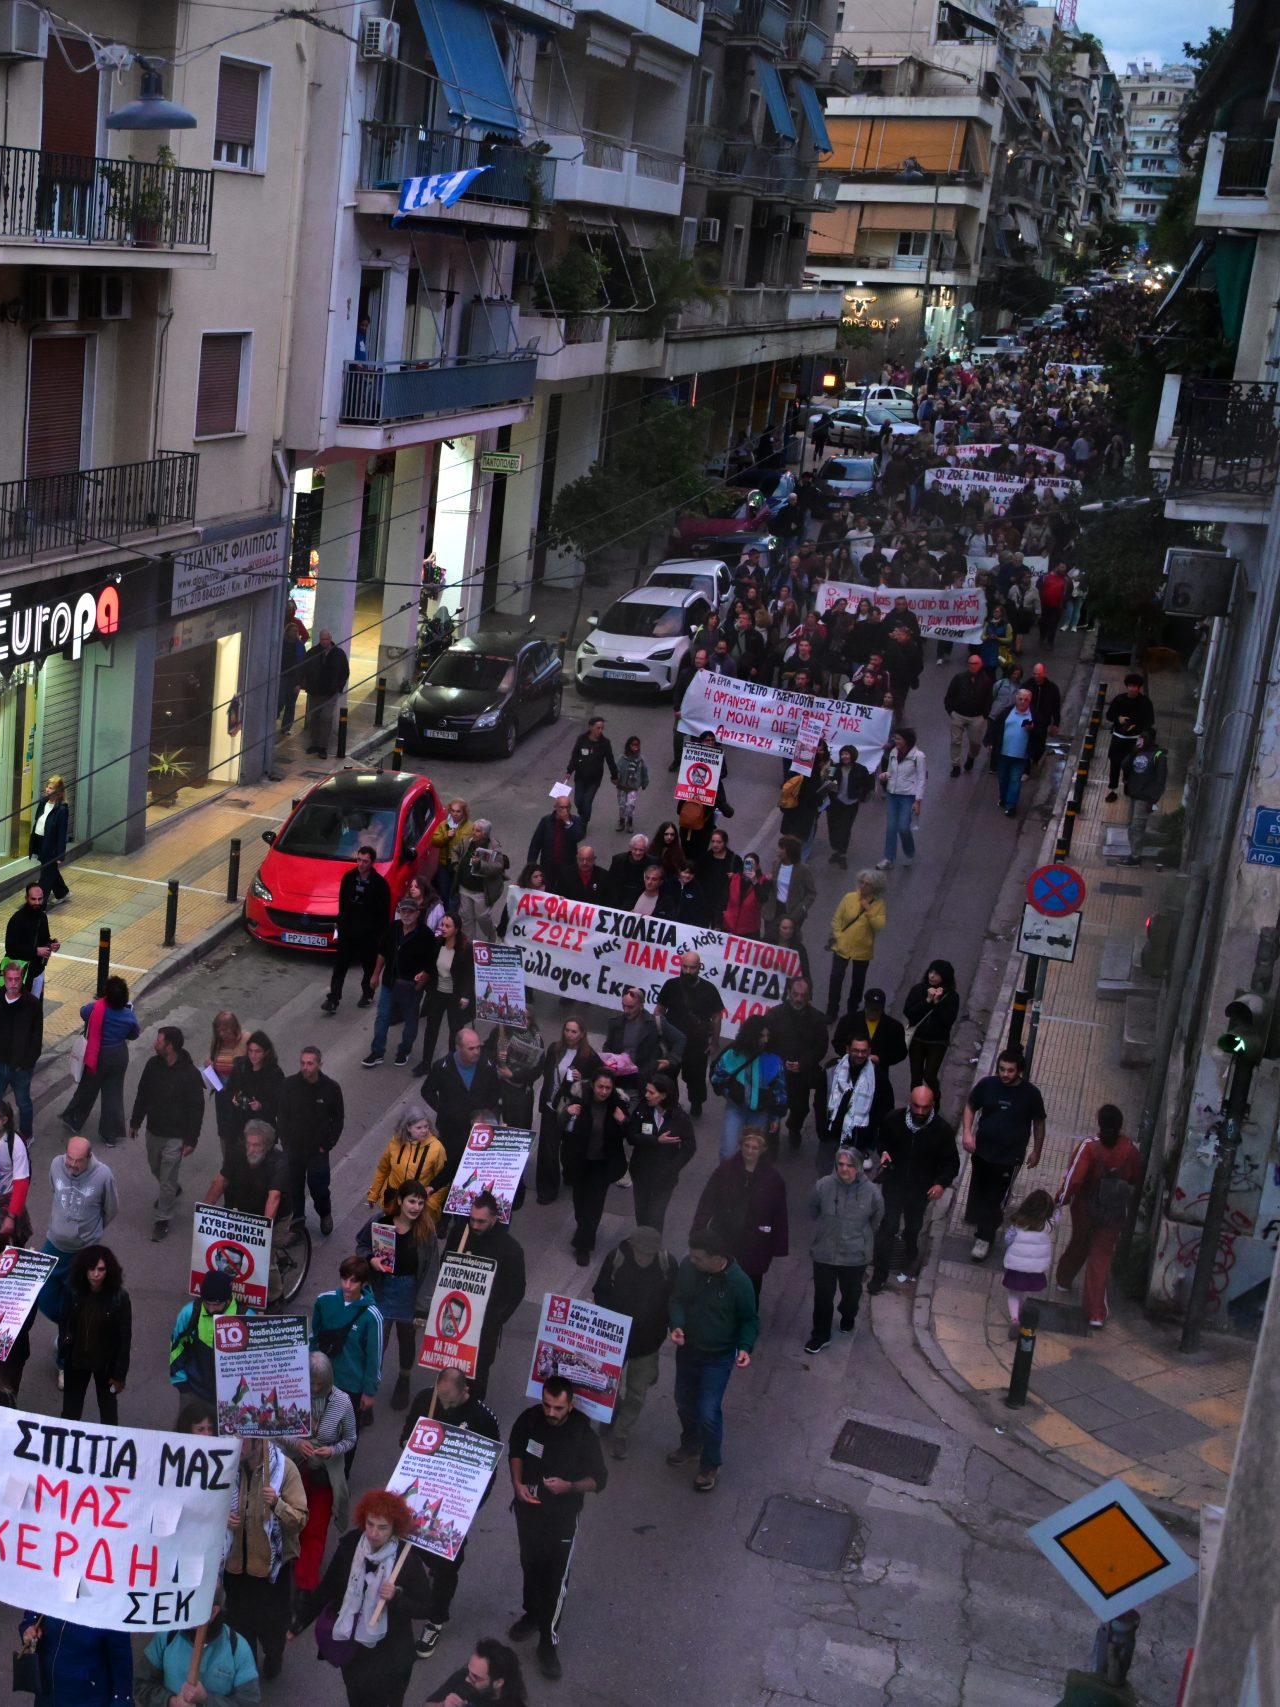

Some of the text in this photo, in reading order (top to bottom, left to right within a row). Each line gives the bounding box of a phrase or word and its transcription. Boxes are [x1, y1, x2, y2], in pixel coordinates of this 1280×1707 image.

[183, 544, 228, 572] ΤΣΙΑΝΤΗΣ
[231, 532, 278, 559] ΦΙΛΙΠΠΟΣ
[726, 711, 760, 729] ΜΟΝΗ
[516, 893, 596, 928] ΑΣΦΑΛΗ
[595, 910, 677, 947] ΣΧΟΛΕΙΑ
[531, 921, 588, 952] ΖΩΕΣ
[593, 938, 621, 959] μας
[472, 1133, 490, 1144] 10
[201, 1216, 264, 1237] ΚΥΒΕΡΝΗΣΗ
[198, 1226, 266, 1247] ΔΟΛΟΦΟΝΩΝ
[443, 1266, 487, 1283] ΚΥΒΕΡΝΗΣΗ
[231, 1282, 246, 1292] ΗΝ
[439, 1277, 487, 1296] ΔΟΛΟΦΟΝΩΝ
[217, 1327, 243, 1344] 10
[249, 1325, 304, 1337] διαδηλώνουμε
[592, 1317, 625, 1336] ΑΠΕΡΓΙΑ
[596, 1329, 623, 1344] ΔΗΜΟΣΙΟ
[433, 1339, 459, 1356] ΝΑ ΤΗΝ
[415, 1430, 438, 1446] 10
[443, 1437, 497, 1458] διαδηλώνουμε
[14, 1420, 138, 1481] ΣΠΙΤΙΑ
[159, 1443, 234, 1491] ΜΑΣ
[34, 1473, 132, 1529] ΜΑΣ
[122, 1590, 196, 1626] ΣΕΚ
